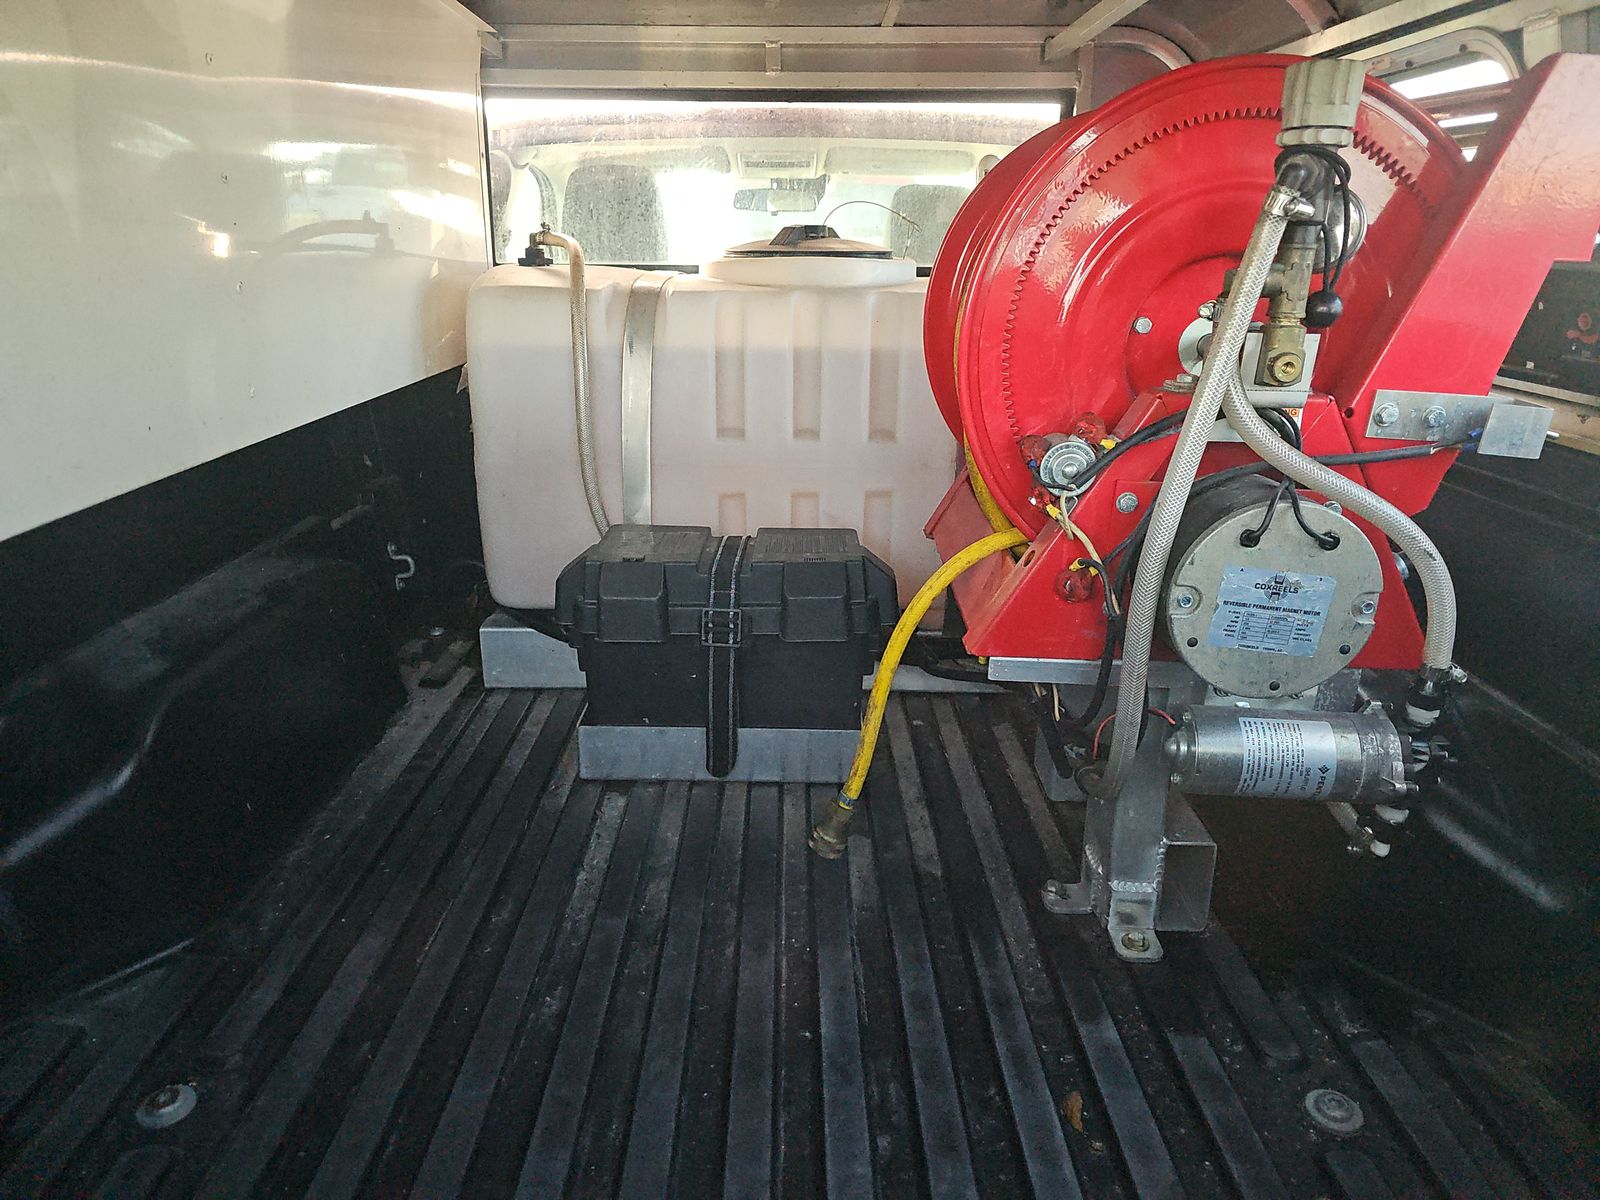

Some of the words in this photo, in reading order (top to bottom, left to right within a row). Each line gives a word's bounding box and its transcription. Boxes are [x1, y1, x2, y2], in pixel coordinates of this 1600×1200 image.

[1254, 582, 1299, 594] COXREELS
[1223, 600, 1251, 608] REVERSIBLE
[1252, 604, 1282, 612] PERMANENT
